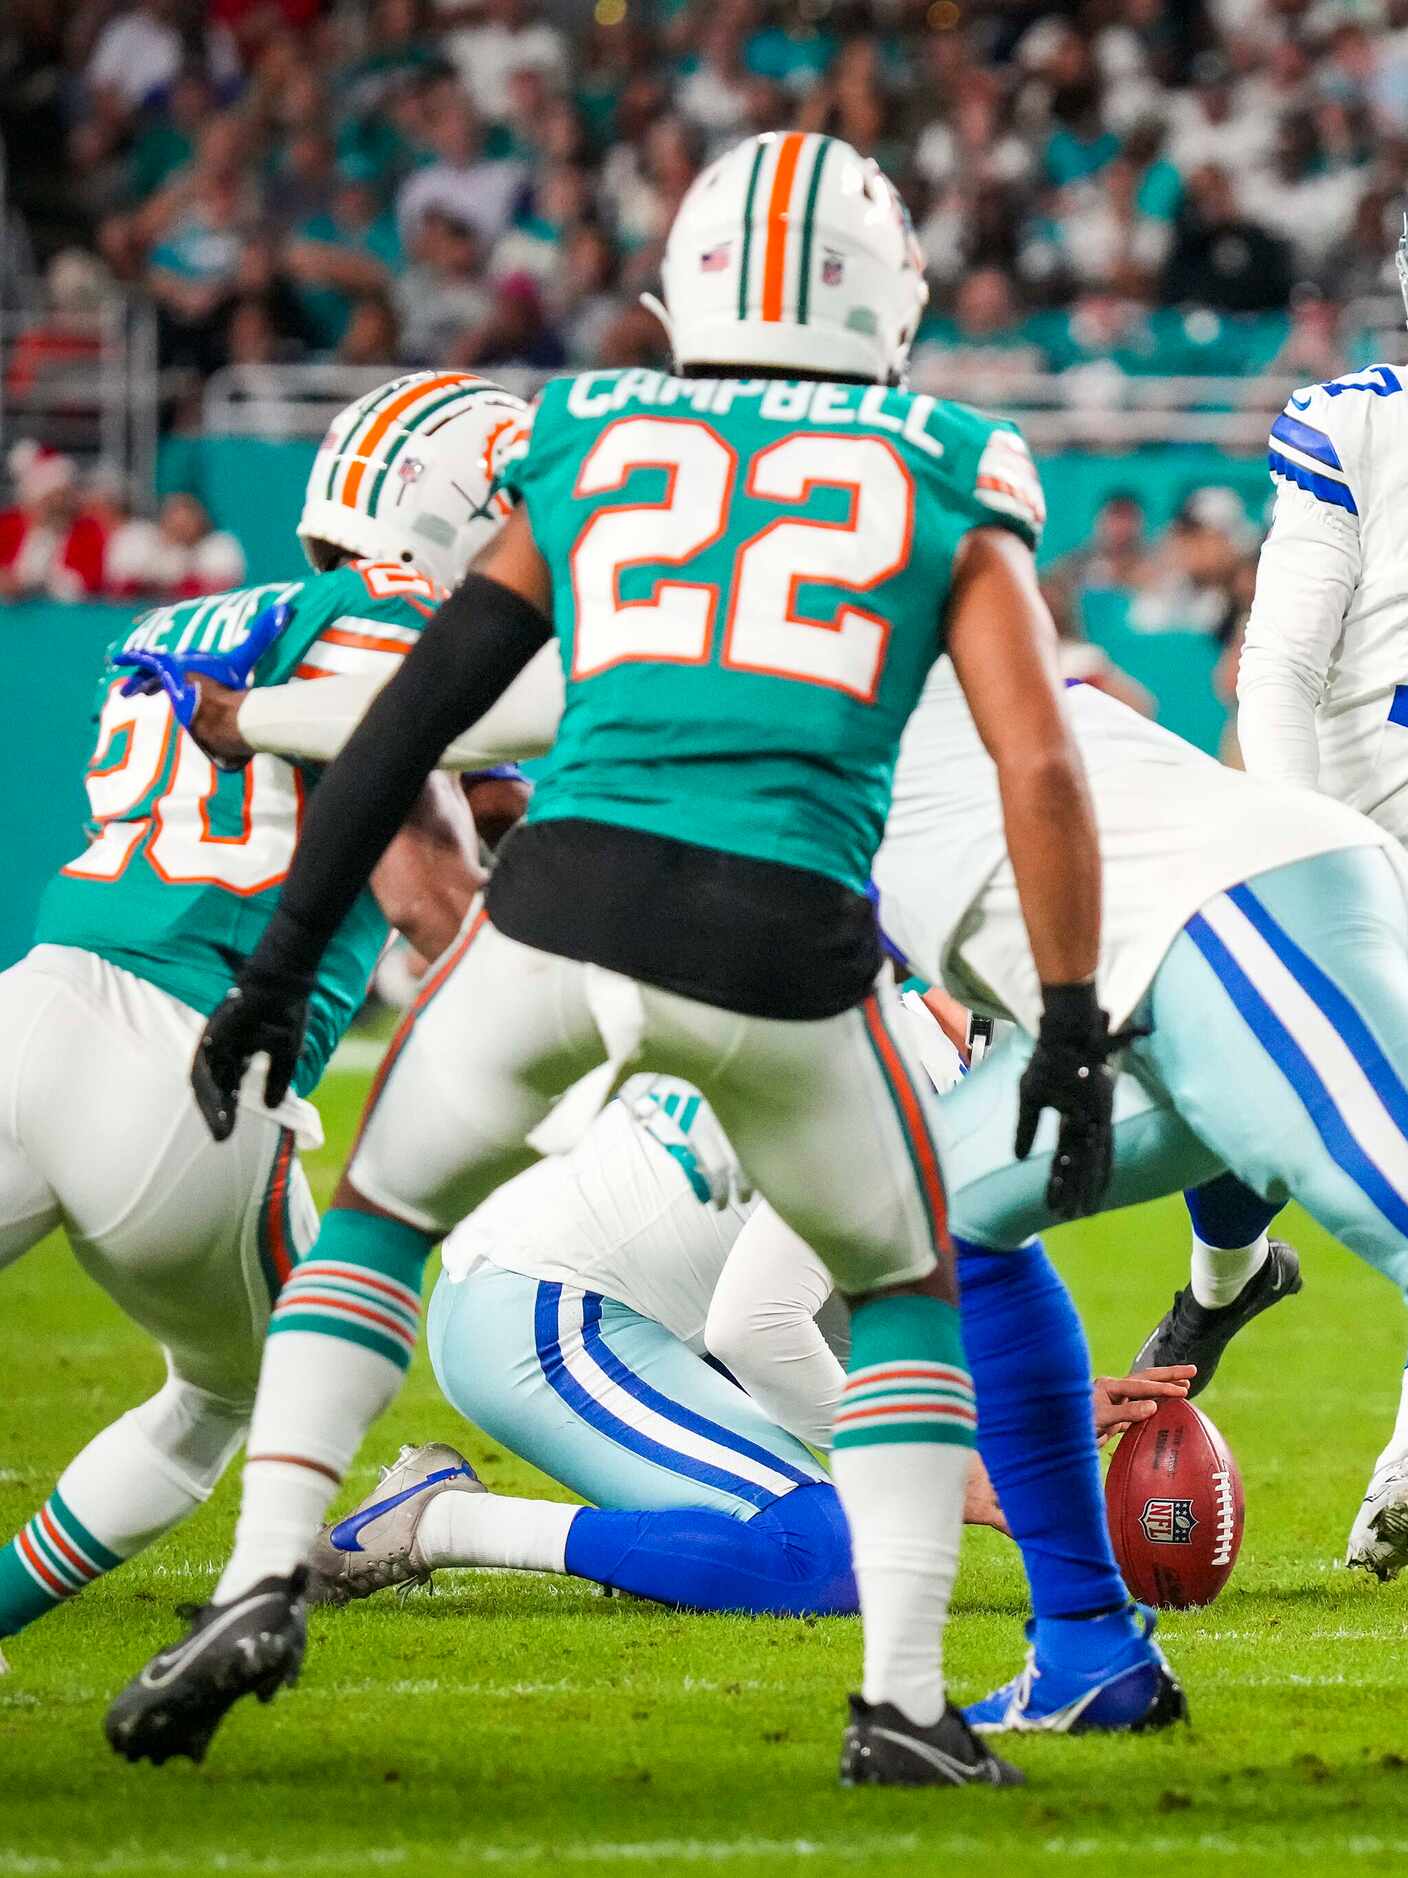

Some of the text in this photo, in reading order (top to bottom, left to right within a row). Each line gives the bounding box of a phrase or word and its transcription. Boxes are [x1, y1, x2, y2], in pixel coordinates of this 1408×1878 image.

[567, 368, 945, 458] CAMPBELL
[1321, 366, 1404, 397] 7
[569, 413, 916, 705] 22
[60, 676, 305, 897] 20
[1147, 1503, 1173, 1538] NFL
